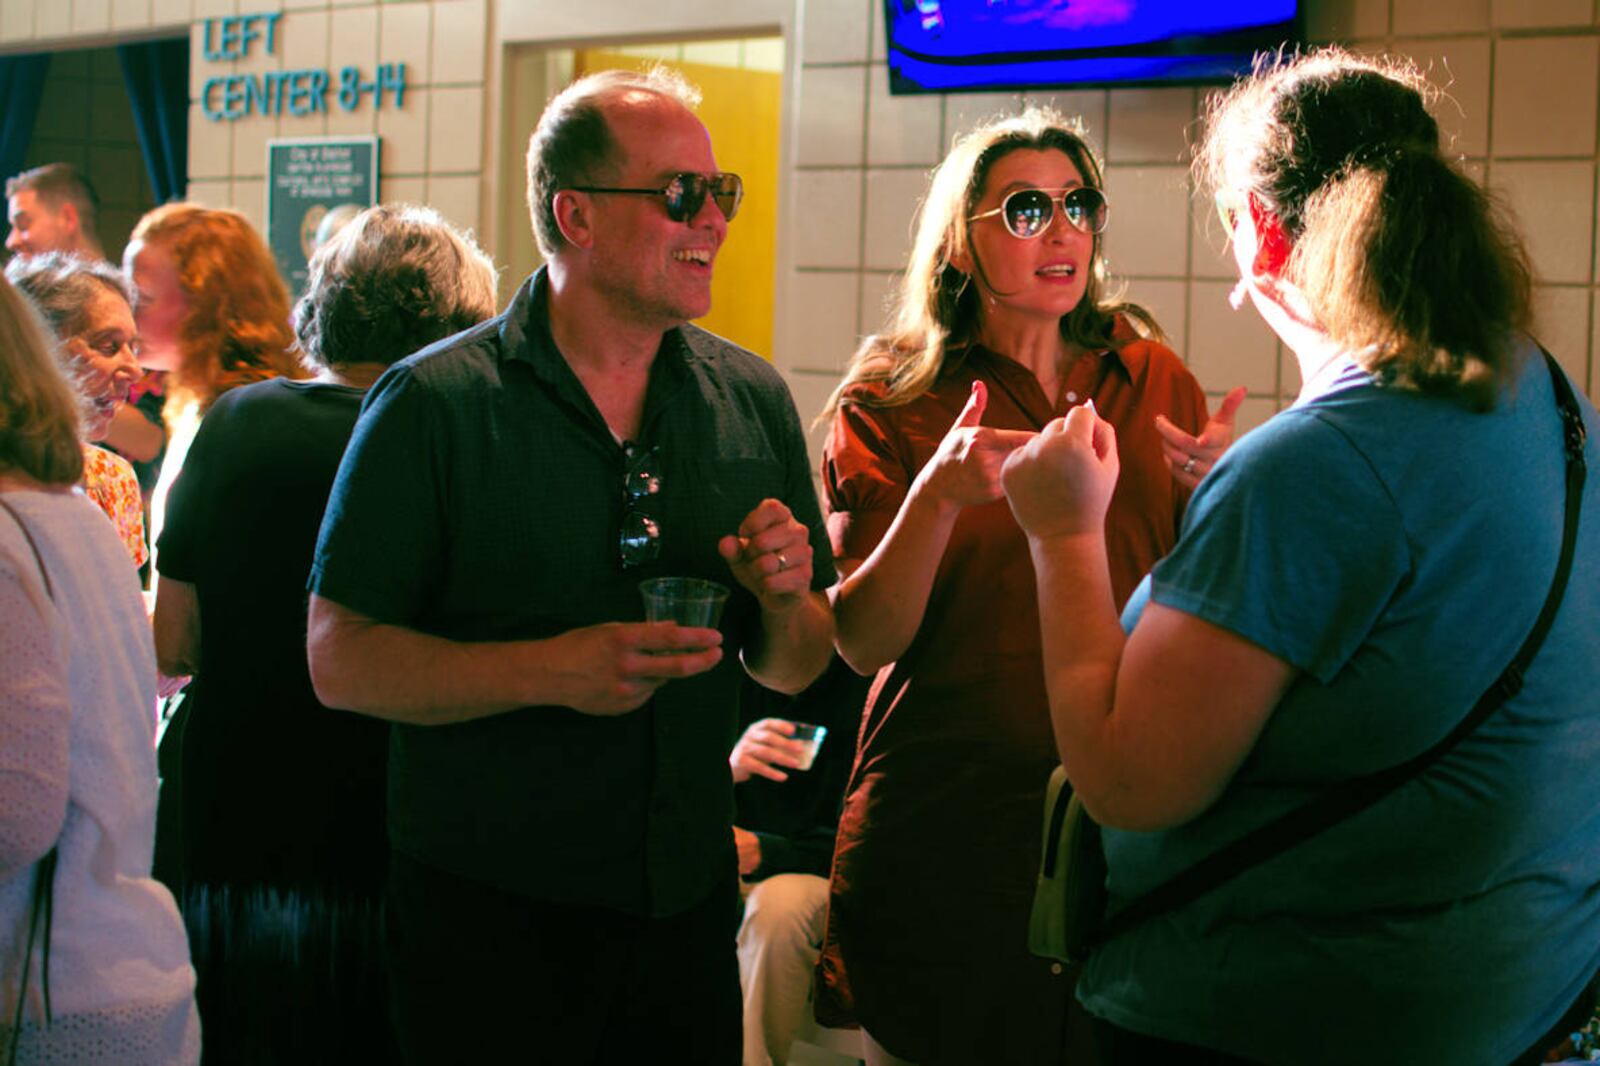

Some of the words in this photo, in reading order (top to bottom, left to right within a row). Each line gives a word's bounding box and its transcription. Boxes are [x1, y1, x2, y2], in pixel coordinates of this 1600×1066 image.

[203, 12, 283, 61] LEFT
[202, 69, 330, 121] CENTER
[338, 63, 406, 112] 8-14
